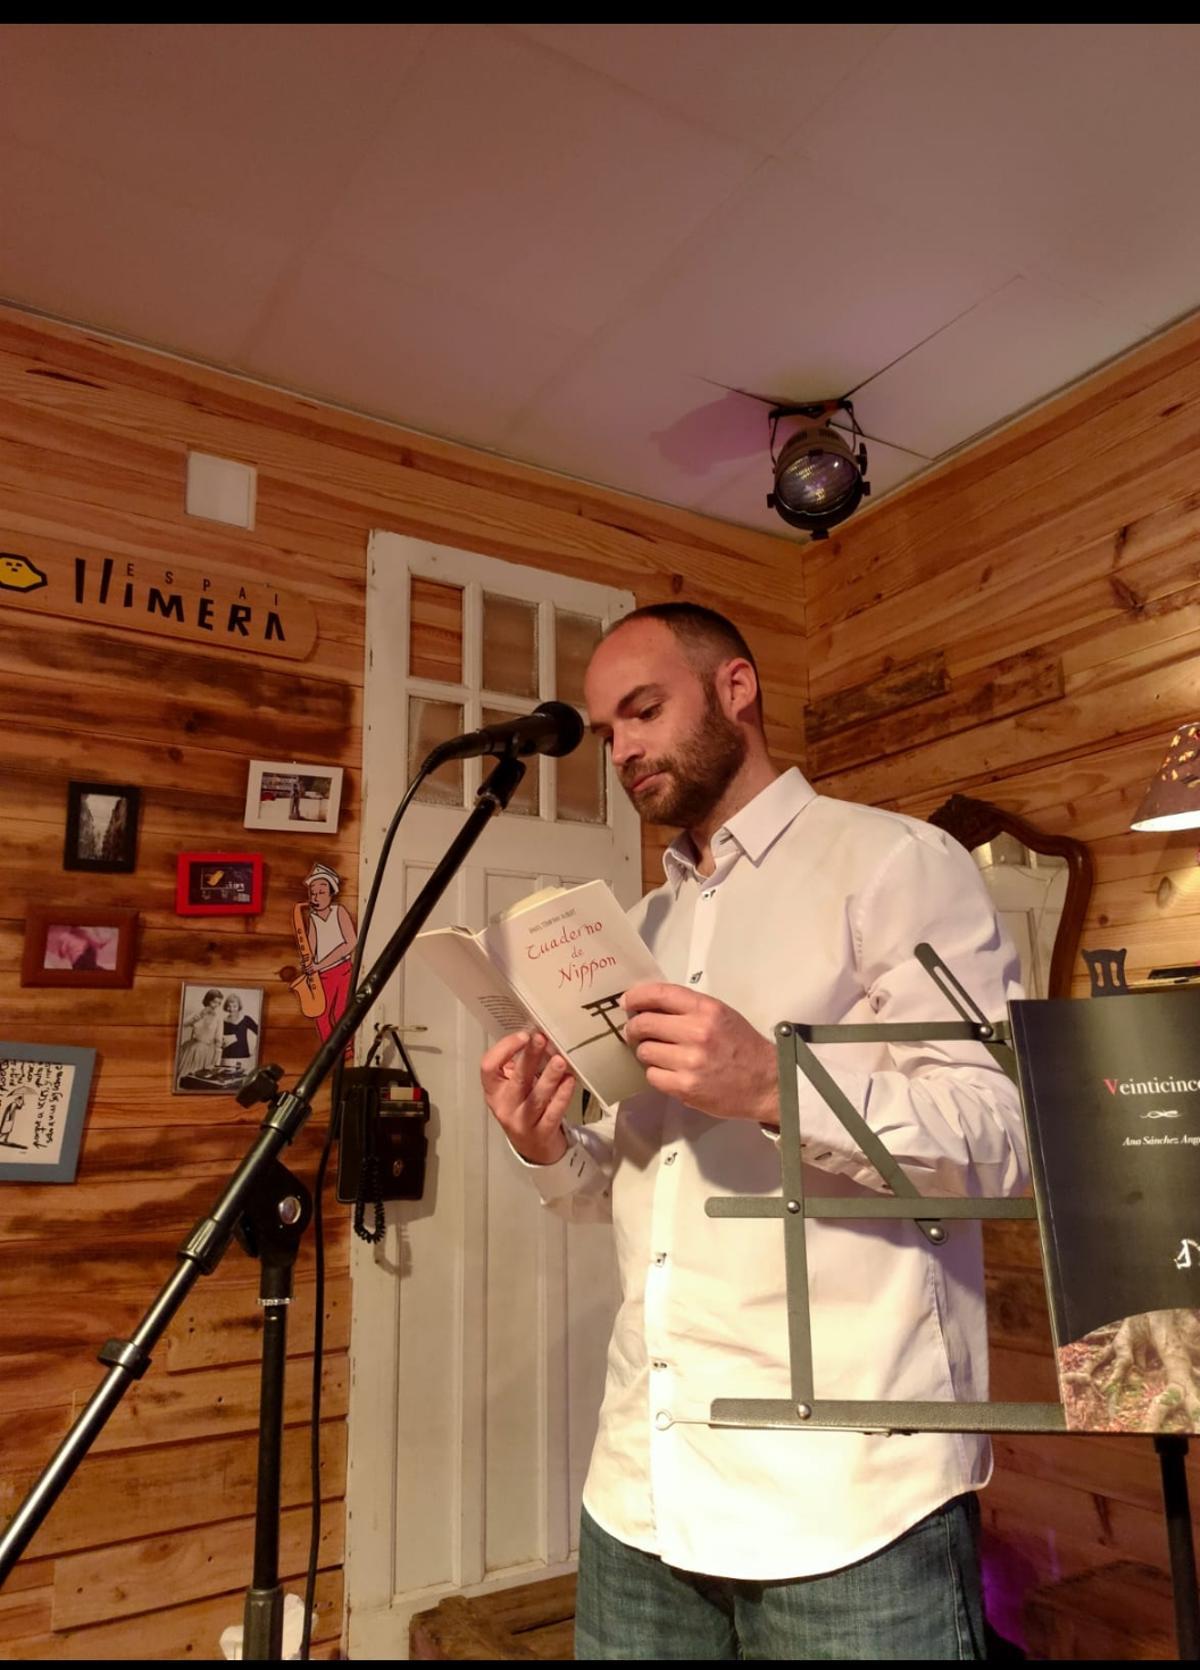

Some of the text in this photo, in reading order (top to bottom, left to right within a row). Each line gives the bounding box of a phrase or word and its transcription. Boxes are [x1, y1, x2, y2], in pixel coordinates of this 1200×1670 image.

[127, 563, 278, 606] ESPAI
[526, 920, 603, 961] Cuaderno
[571, 944, 583, 959] de
[558, 956, 617, 992] Nippon
[1122, 1136, 1142, 1147] Ana
